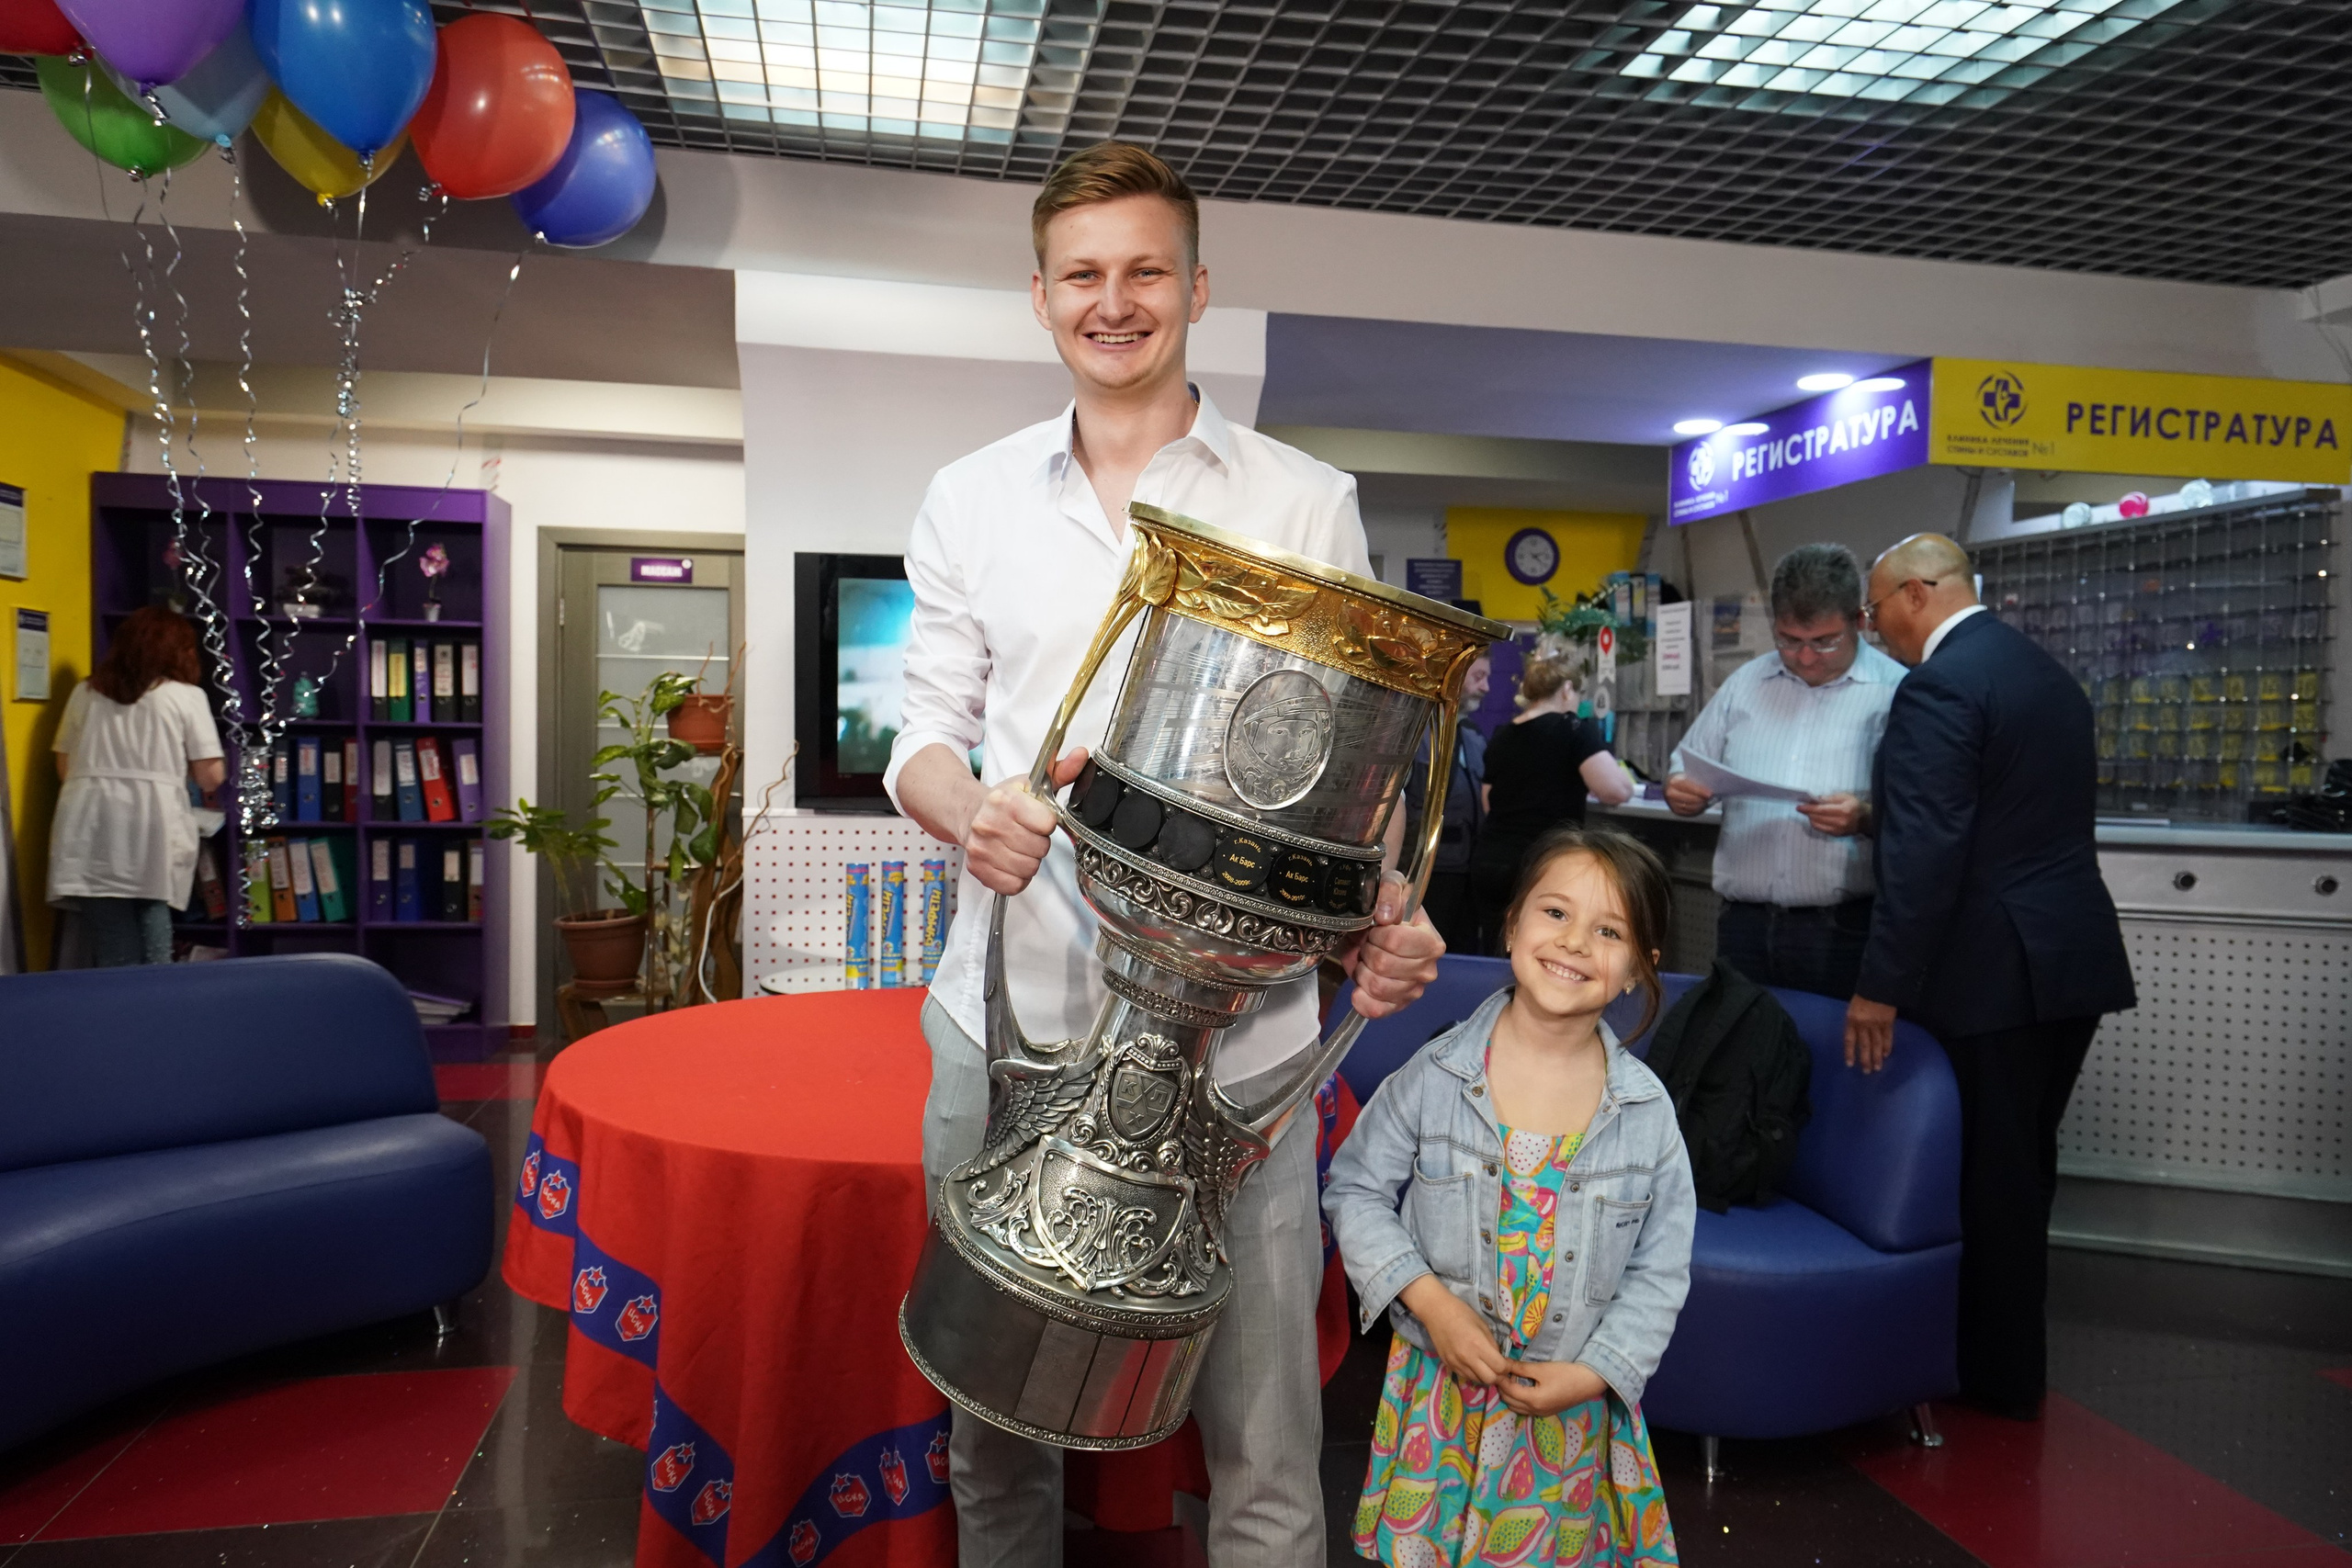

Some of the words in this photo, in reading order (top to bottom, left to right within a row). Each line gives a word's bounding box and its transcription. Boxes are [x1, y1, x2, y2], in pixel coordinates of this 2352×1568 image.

[2066, 402, 2338, 450] РЕГИСТРАТУРА
[1732, 400, 1919, 481] РЕГИСТРАТУРА
[1233, 837, 1261, 853] г.Казань
[1228, 853, 1239, 863] Ак
[1238, 855, 1256, 869] Барс
[1287, 853, 1314, 867] г.Казань
[1285, 870, 1295, 879] Ак
[1294, 872, 1308, 884] Барс
[923, 888, 943, 947] БУМФЕТИ
[1121, 1079, 1137, 1097] К
[1150, 1089, 1168, 1105] Л
[542, 1187, 561, 1210] ЦСКА
[579, 1278, 593, 1307] ЦСКА
[628, 1308, 644, 1333] ЦСКА
[664, 1455, 677, 1485] ЦСКА
[704, 1489, 716, 1518] ЦСКА
[836, 1493, 865, 1504] ЦСКА
